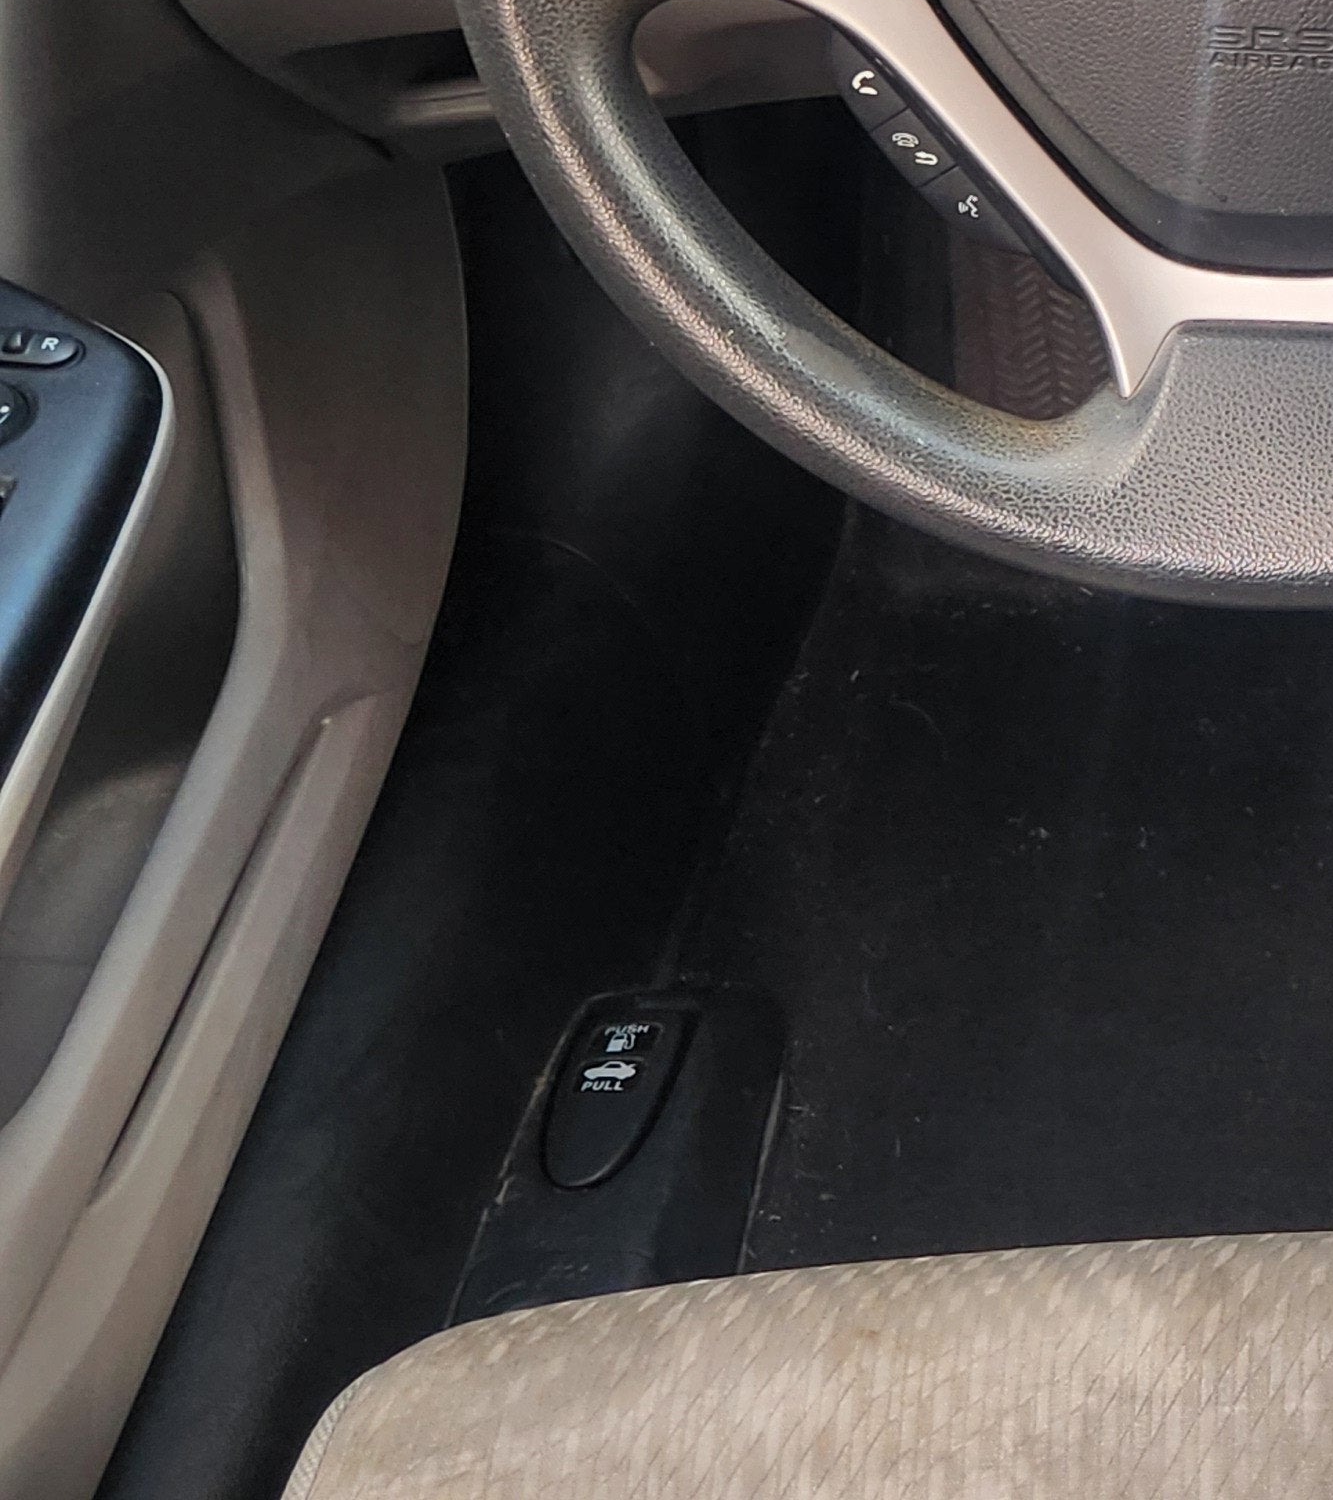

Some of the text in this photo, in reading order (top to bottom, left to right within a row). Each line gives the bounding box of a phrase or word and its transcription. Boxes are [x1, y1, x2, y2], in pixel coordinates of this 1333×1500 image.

[40, 337, 60, 352] R
[604, 1024, 650, 1036] PUSH
[580, 1080, 624, 1092] PULL
